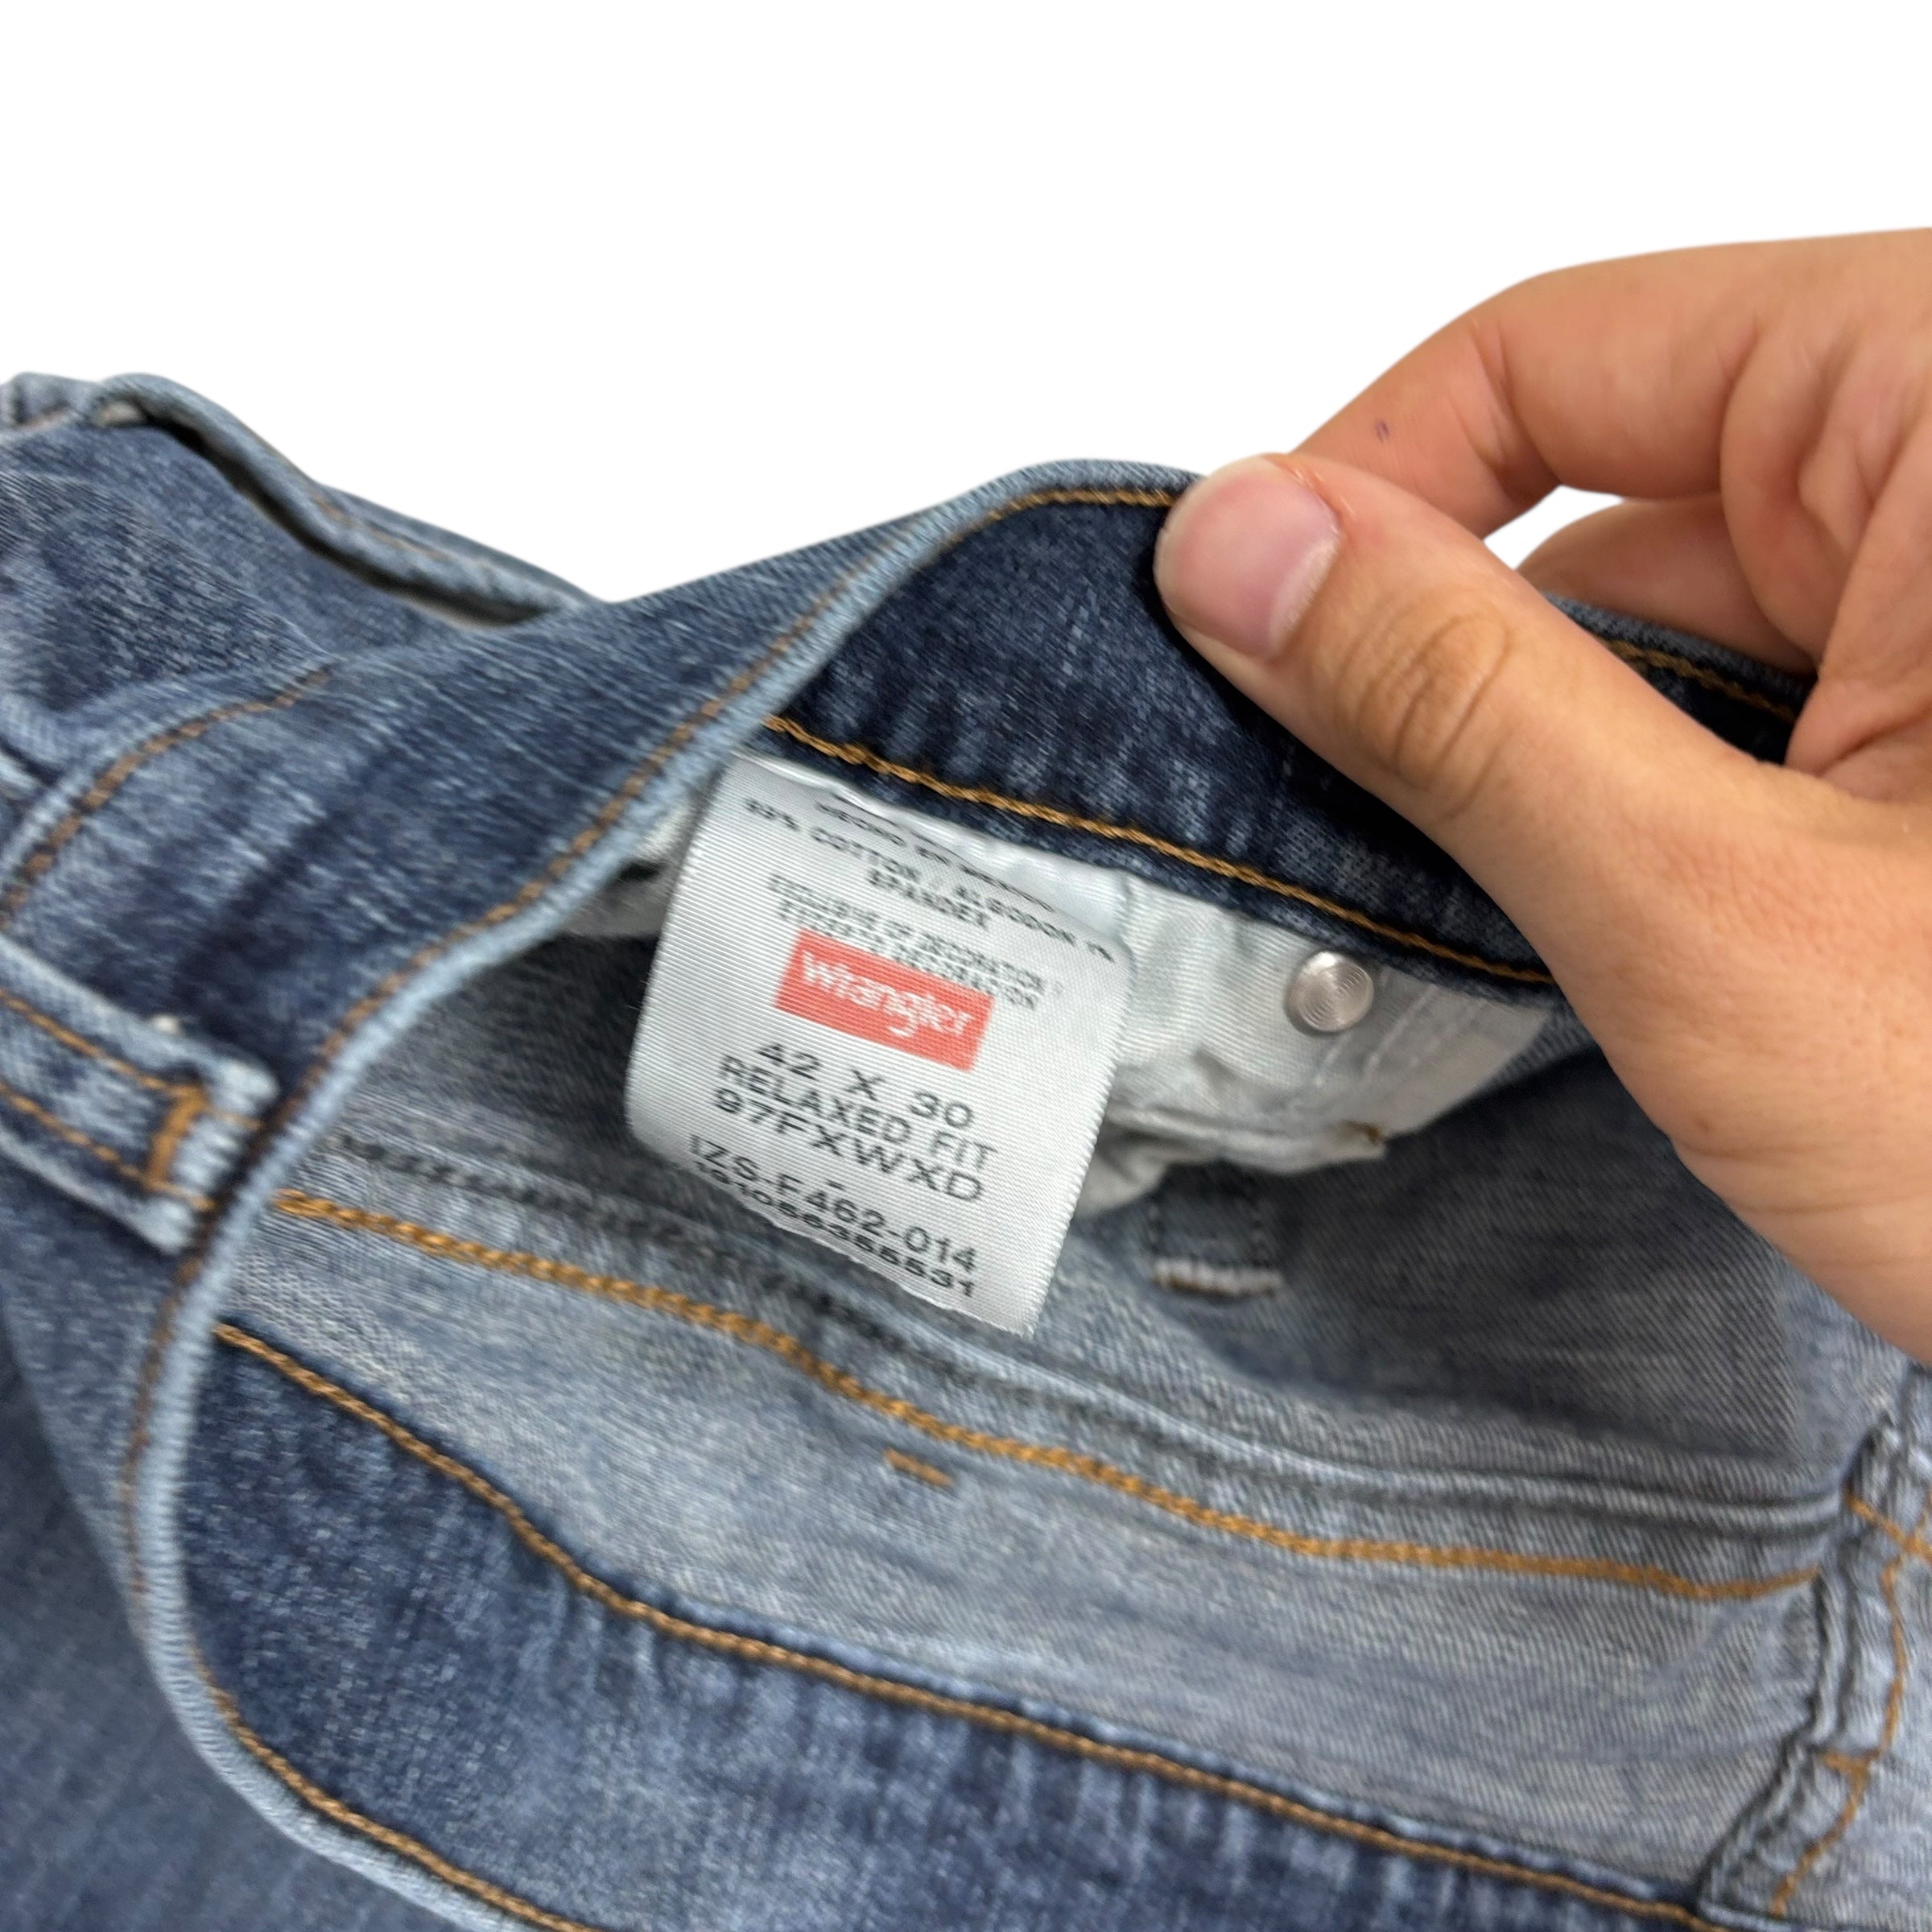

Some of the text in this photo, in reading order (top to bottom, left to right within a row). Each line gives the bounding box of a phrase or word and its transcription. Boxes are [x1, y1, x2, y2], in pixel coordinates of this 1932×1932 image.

[719, 1055, 998, 1172] RELAXED FIT
[758, 1043, 822, 1081] 42
[908, 1090, 975, 1129] 30
[716, 1088, 984, 1202] 97FXWXD
